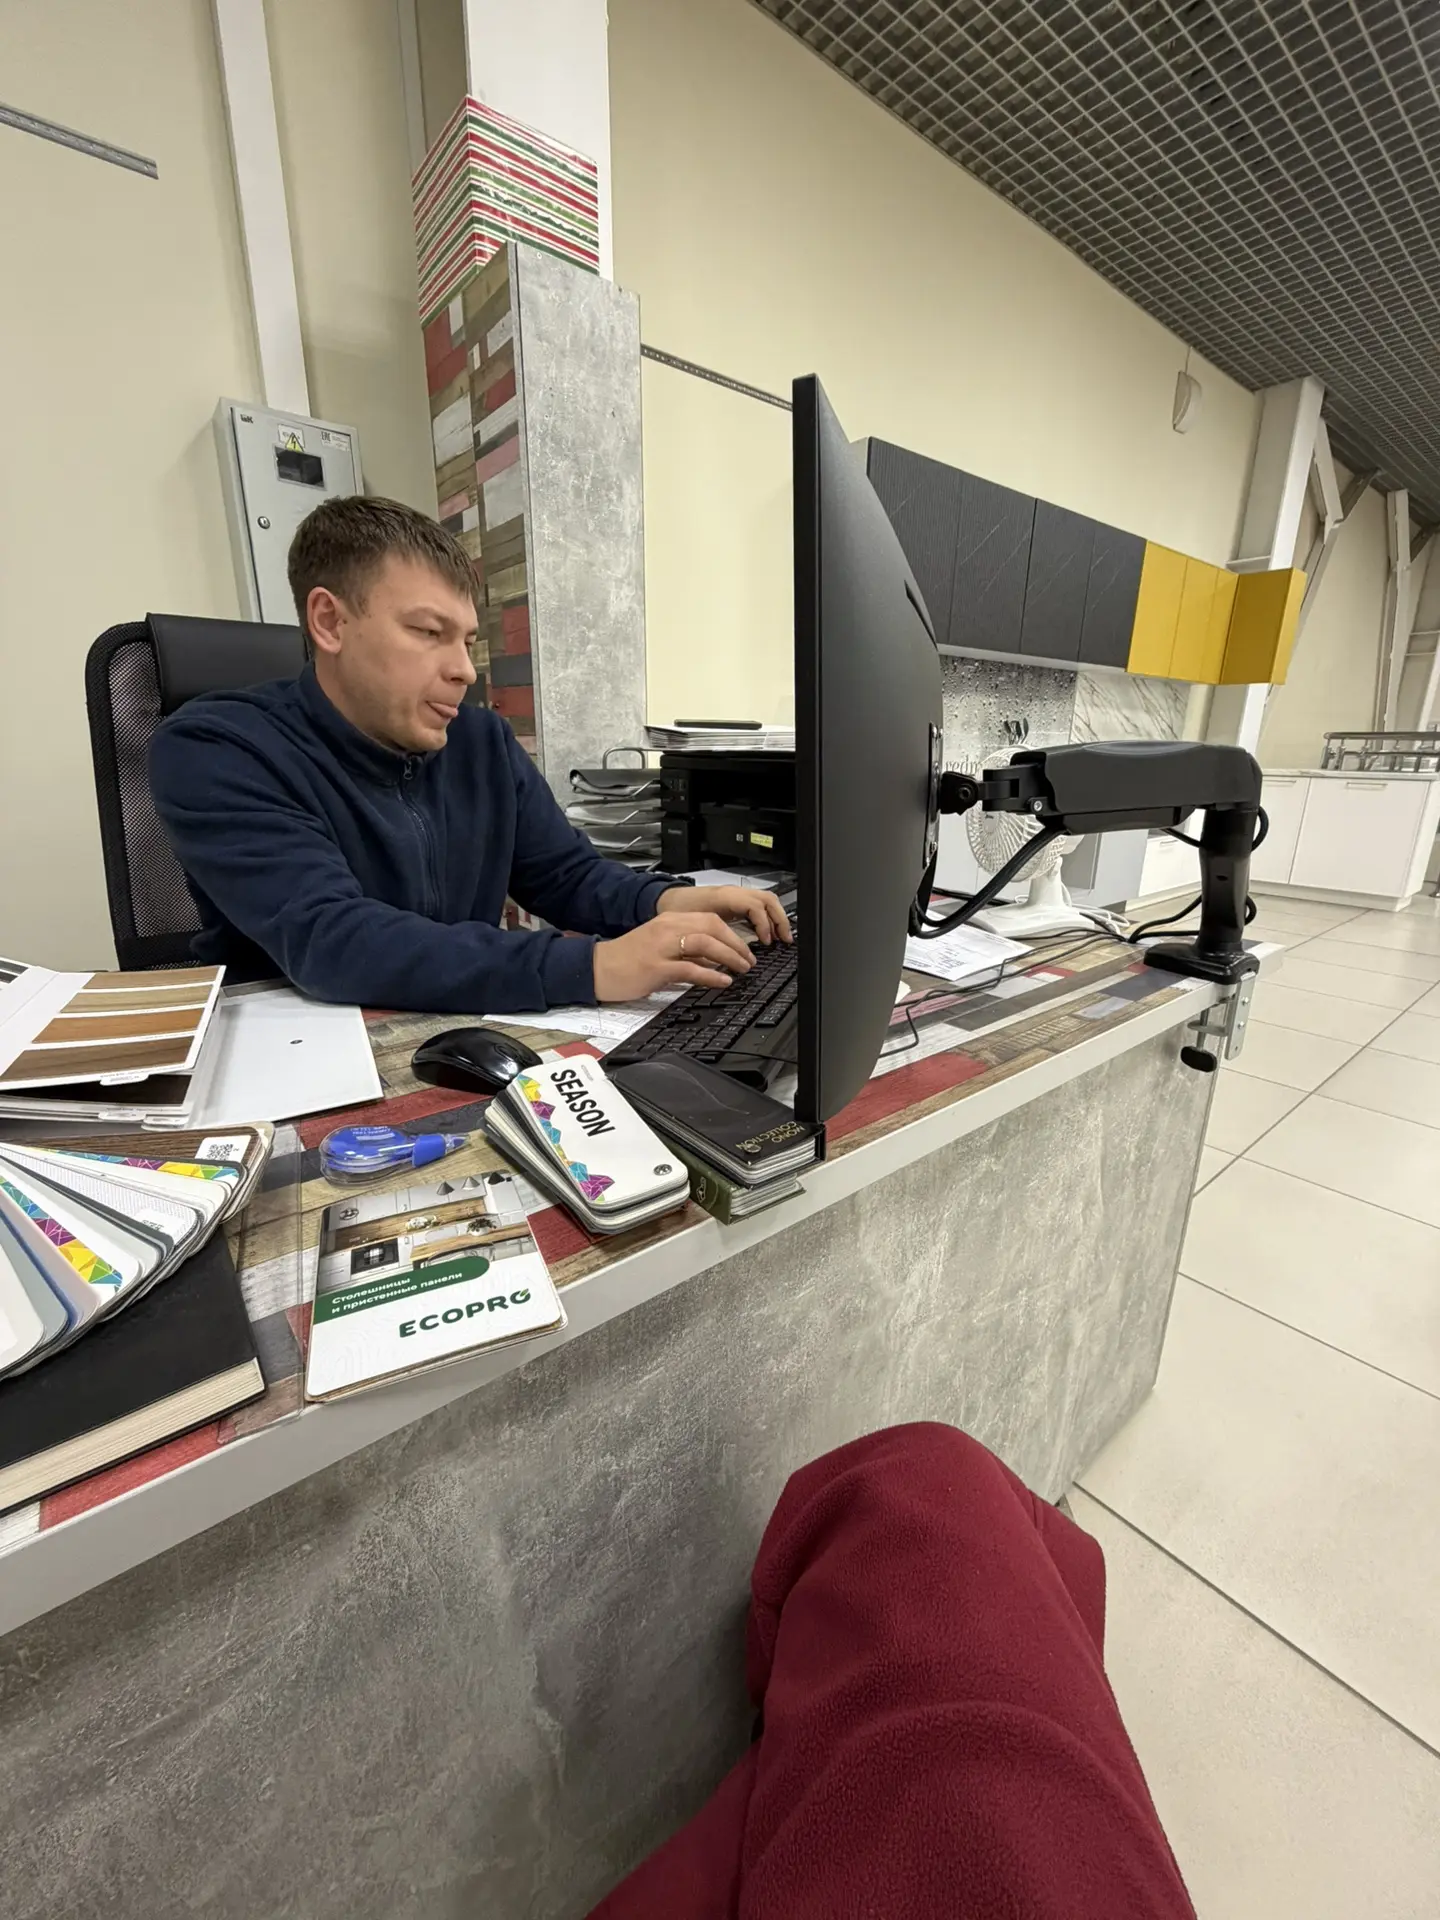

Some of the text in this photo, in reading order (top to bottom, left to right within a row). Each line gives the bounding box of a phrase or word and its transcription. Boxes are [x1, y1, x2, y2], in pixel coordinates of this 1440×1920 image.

[550, 1069, 616, 1137] SEASON
[771, 1125, 806, 1143] MONO
[332, 1278, 411, 1304] Столешницы
[343, 1284, 418, 1311] пристенные
[420, 1273, 463, 1289] панели
[399, 1288, 532, 1338] ECOPRO
